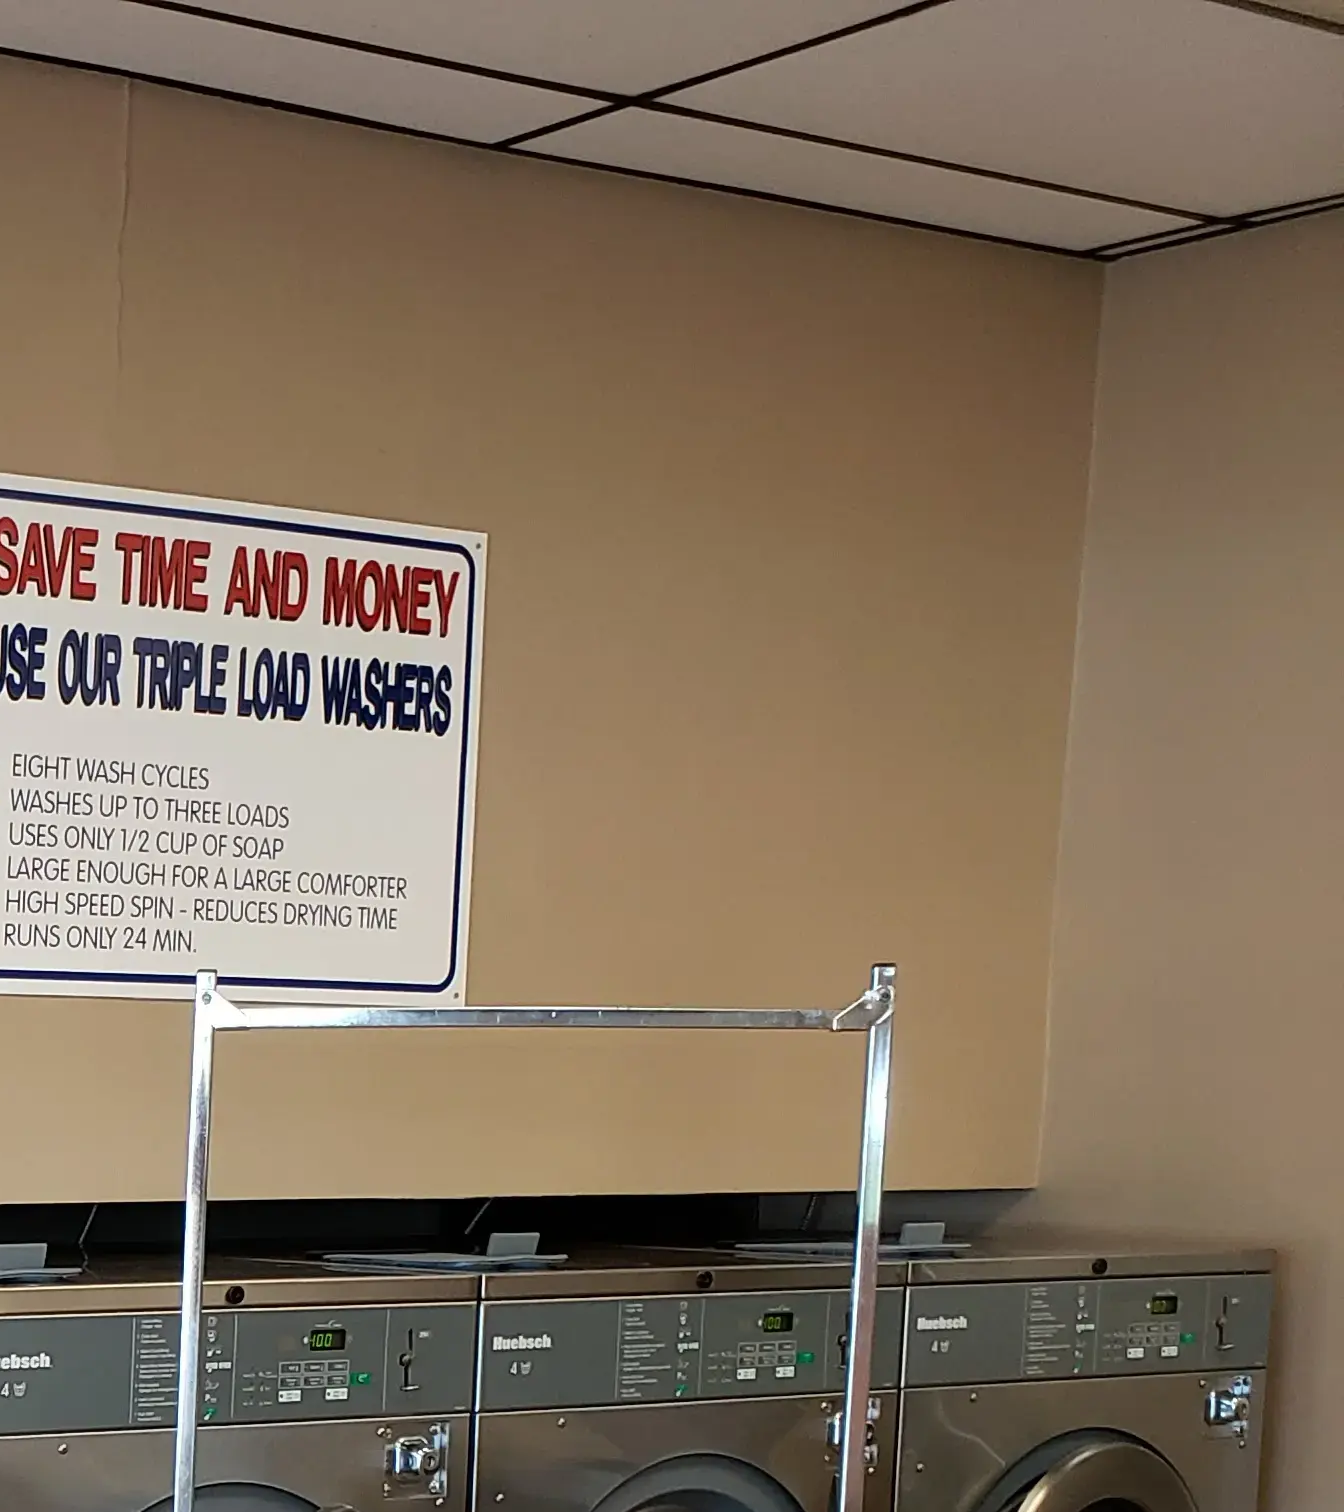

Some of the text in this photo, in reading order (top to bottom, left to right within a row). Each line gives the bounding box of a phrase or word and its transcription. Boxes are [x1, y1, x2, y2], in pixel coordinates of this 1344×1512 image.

[114, 531, 212, 614] TIME
[223, 545, 309, 623] AND
[322, 556, 461, 639] MONEY
[57, 628, 122, 707] OUR
[132, 636, 230, 716] TRIPLE
[236, 646, 311, 722] LOAD
[320, 654, 453, 737] WASHERS
[12, 753, 210, 790] EIGHT WASH CYCLES
[10, 788, 290, 829] WASHES UP TO THREE LOADS
[9, 822, 284, 860] USES ONLY 1/2 CUP OF SOAP
[7, 855, 407, 900] LARGE ENOUGH FOR A LARGE COMFORTER
[5, 889, 59, 914] HIGH
[64, 892, 125, 917] SPEED
[130, 895, 174, 919] SPIN
[193, 898, 278, 924] REDUCES
[283, 902, 352, 928] DRYING
[357, 906, 398, 930] TIME
[4, 923, 197, 953] RUNS ONLY 24 MIN.
[492, 1334, 552, 1350] Huebsch
[0, 1382, 9, 1398] 4
